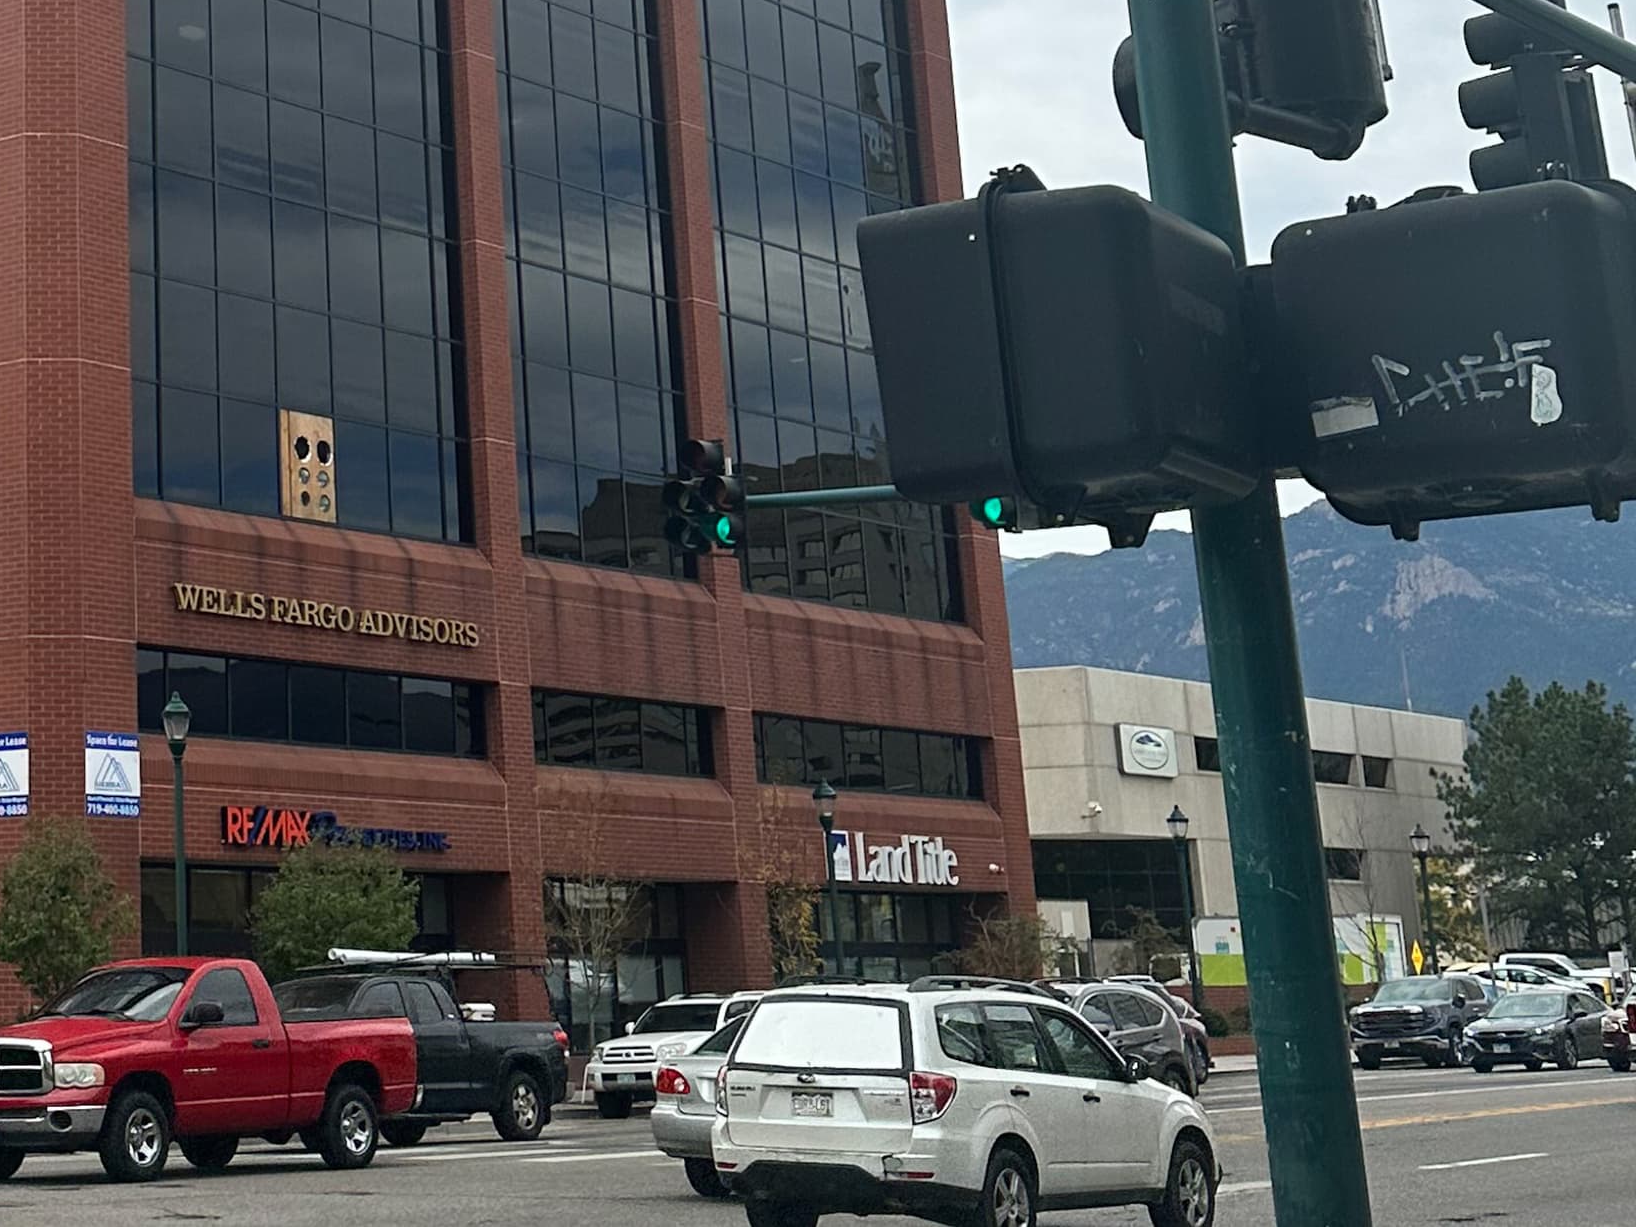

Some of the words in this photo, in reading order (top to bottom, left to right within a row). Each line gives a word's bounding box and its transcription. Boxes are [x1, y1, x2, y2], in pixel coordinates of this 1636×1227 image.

[174, 582, 265, 621] WELLS
[271, 595, 355, 632] FARGO
[360, 609, 480, 647] ADVISORS
[5, 735, 27, 746] Lease
[86, 733, 107, 747] Space
[107, 733, 118, 746] for
[227, 805, 312, 846] RE/MAX
[853, 831, 914, 884] Land
[909, 836, 960, 886] Title
